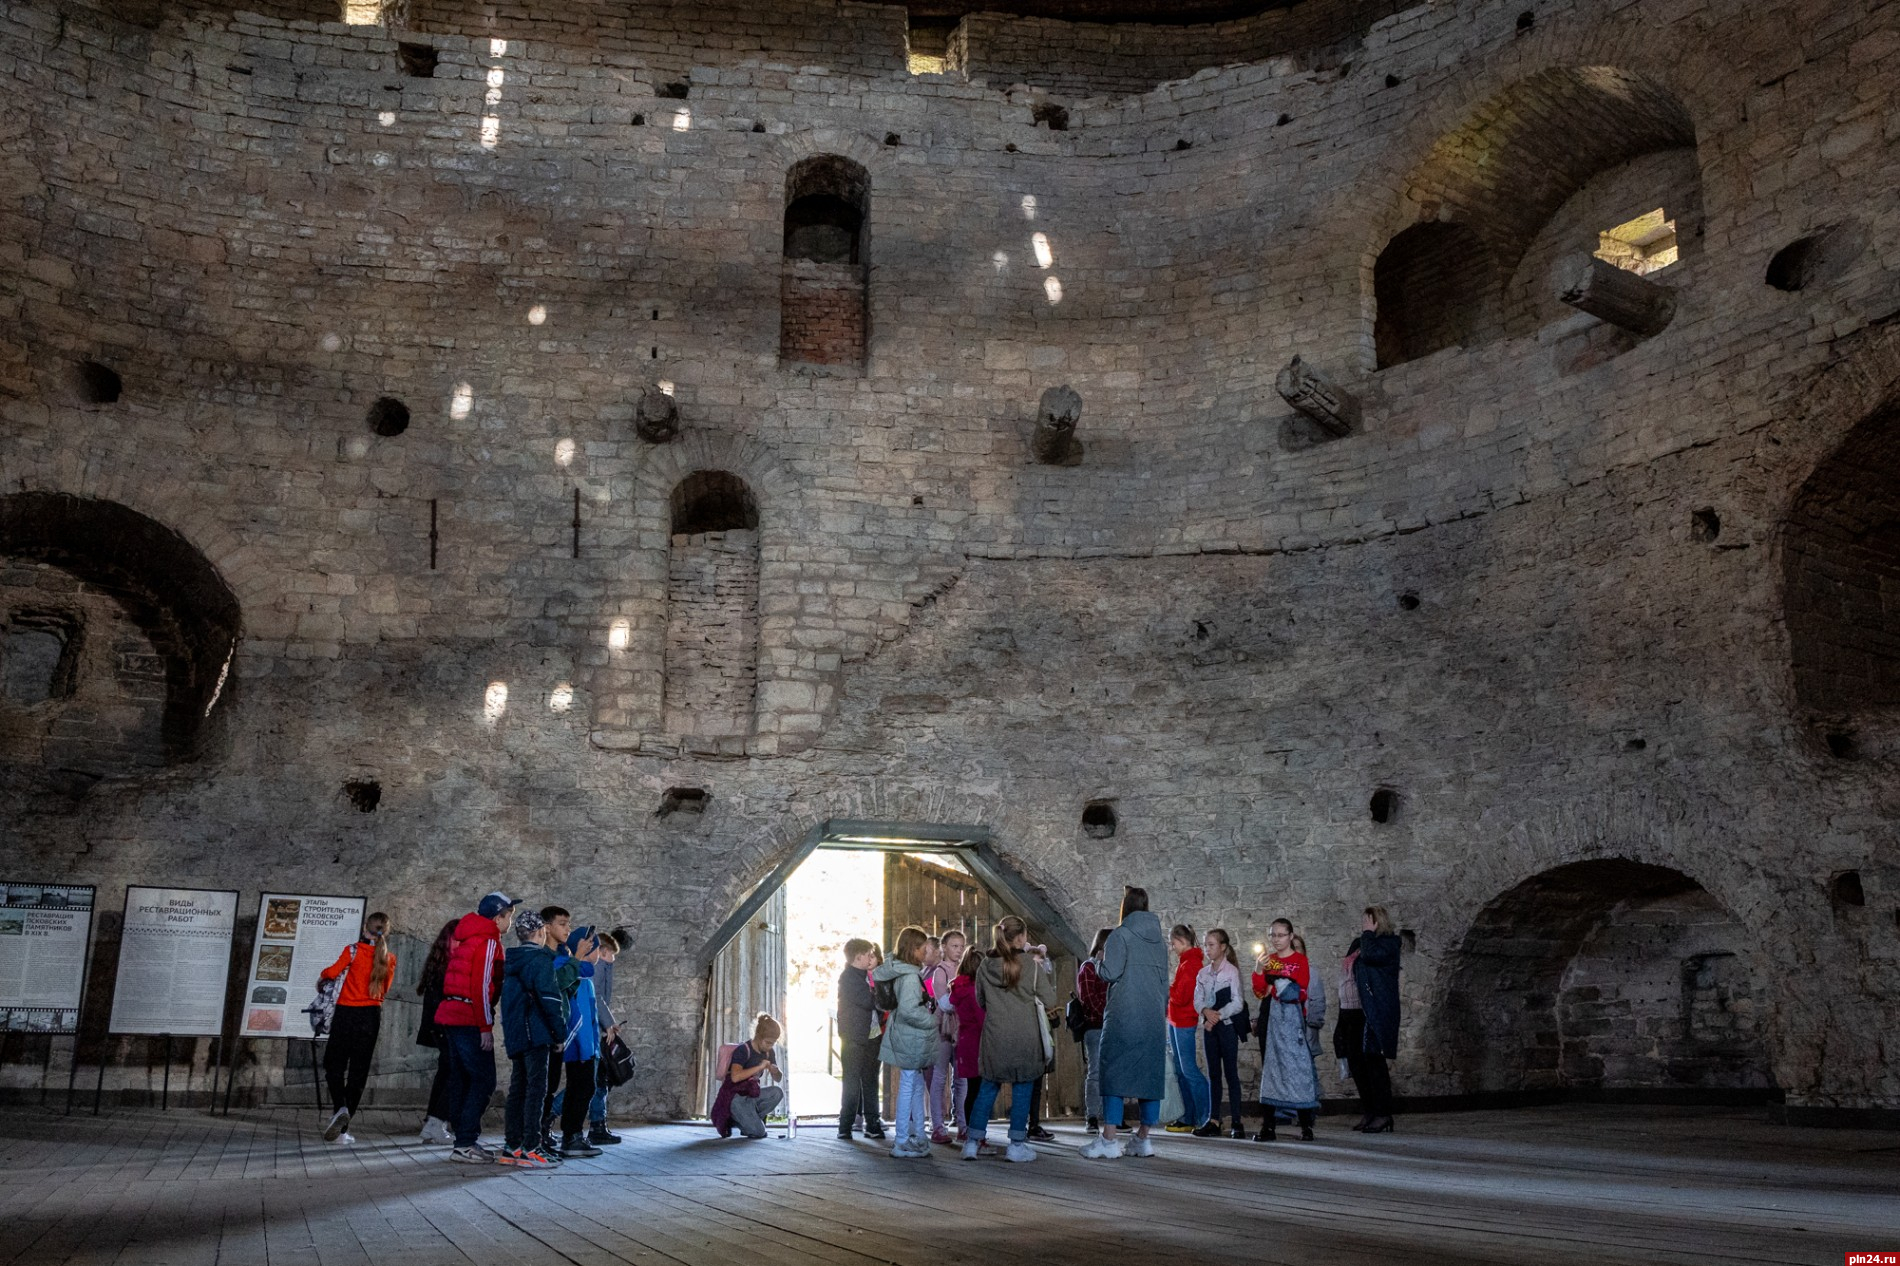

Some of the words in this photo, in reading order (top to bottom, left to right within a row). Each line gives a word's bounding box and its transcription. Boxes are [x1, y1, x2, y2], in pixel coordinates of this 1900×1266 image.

[169, 899, 194, 907] ВИДЫ
[139, 906, 222, 916] РЕСТАВРАЦИОННЫХ
[304, 906, 360, 914] СТРОИТЕЛЬСТВА
[303, 912, 344, 920] ПСКОВСКОЙ
